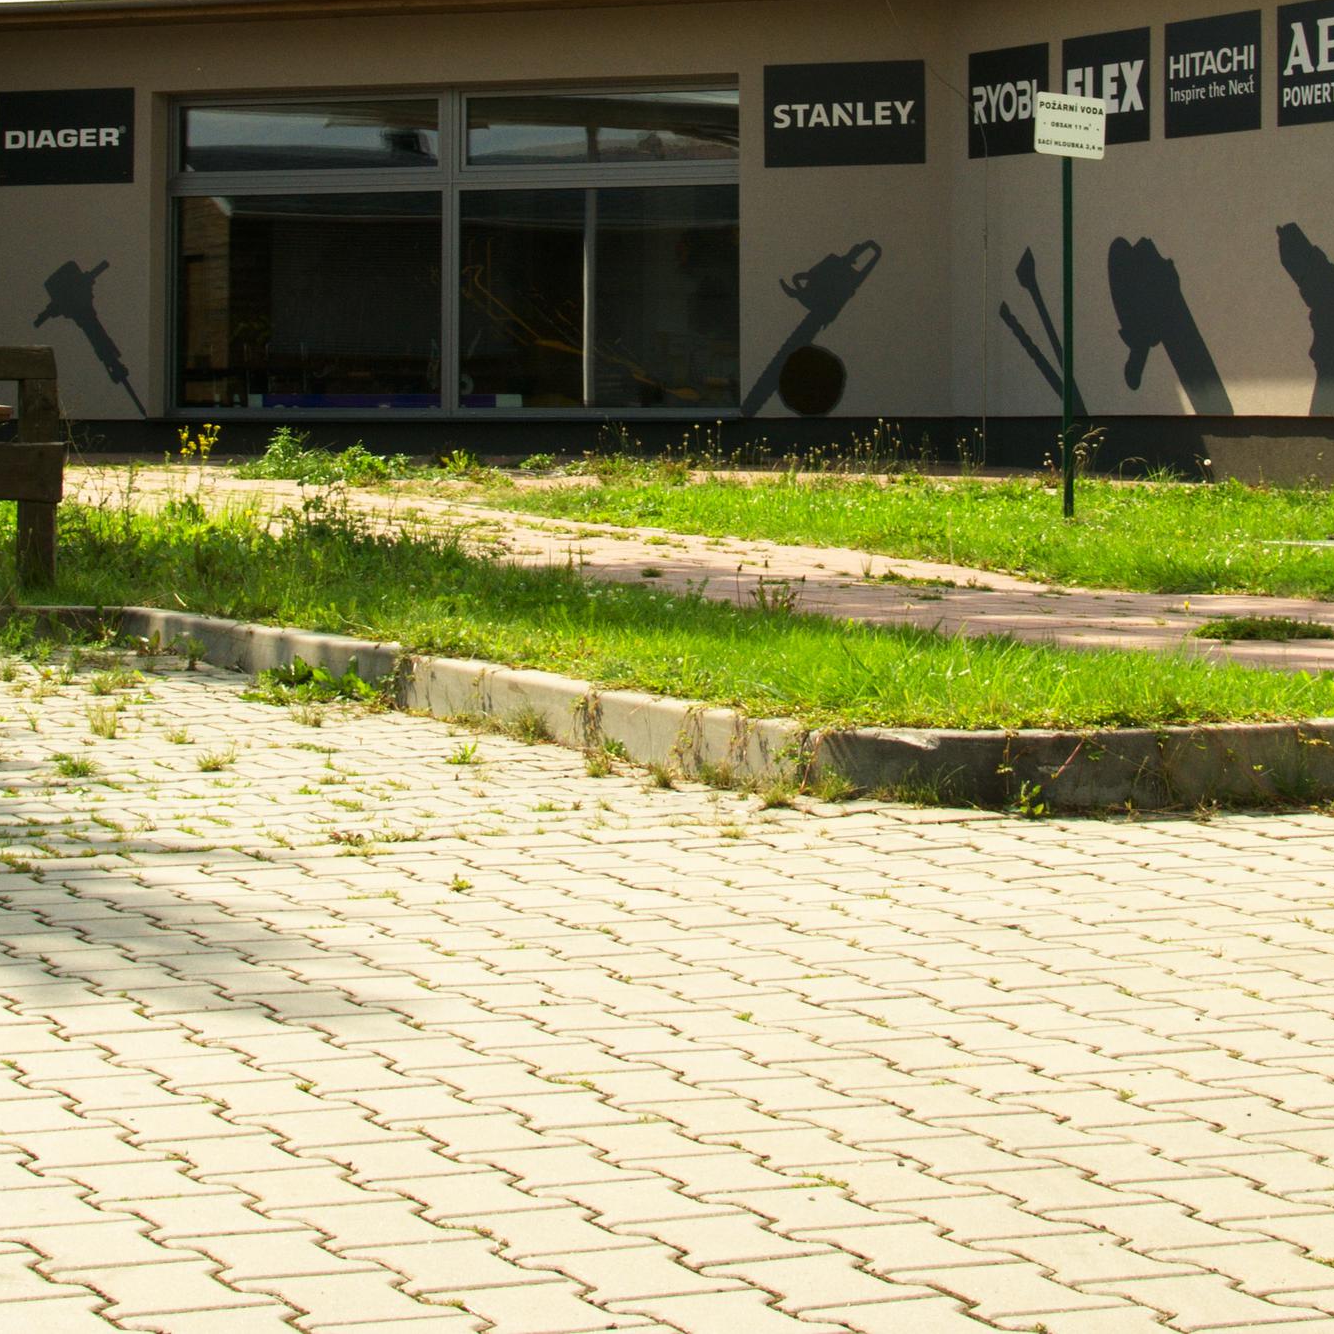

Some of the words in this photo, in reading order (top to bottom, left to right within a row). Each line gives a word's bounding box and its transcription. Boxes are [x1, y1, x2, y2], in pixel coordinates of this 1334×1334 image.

[1169, 44, 1255, 80] HITACHI
[1170, 86, 1206, 105] Inspire
[1209, 81, 1226, 98] the
[1229, 74, 1255, 97] Next
[773, 100, 915, 129] STANLEY
[1080, 106, 1104, 116] VODA
[5, 127, 120, 149] DIAGER
